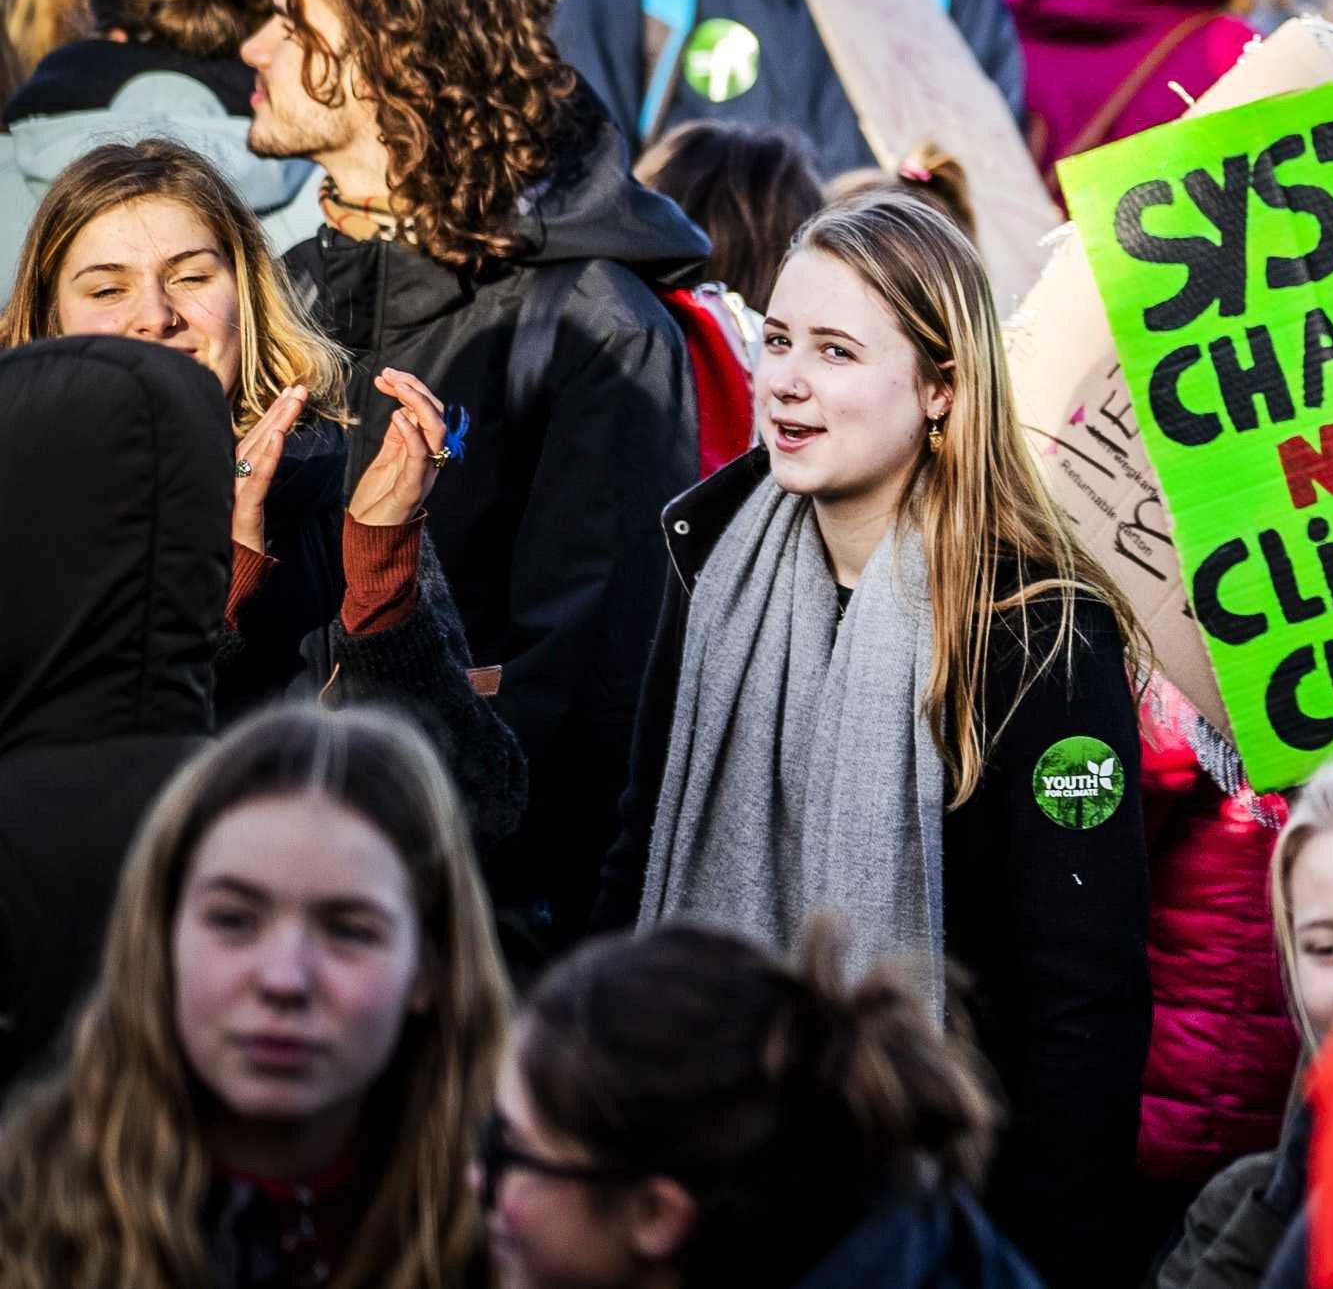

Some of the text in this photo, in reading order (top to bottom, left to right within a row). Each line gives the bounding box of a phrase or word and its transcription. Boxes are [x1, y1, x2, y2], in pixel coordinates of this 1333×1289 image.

[1042, 775, 1098, 790] YOUTH
[1045, 789, 1099, 798] FOR CLIMATE
